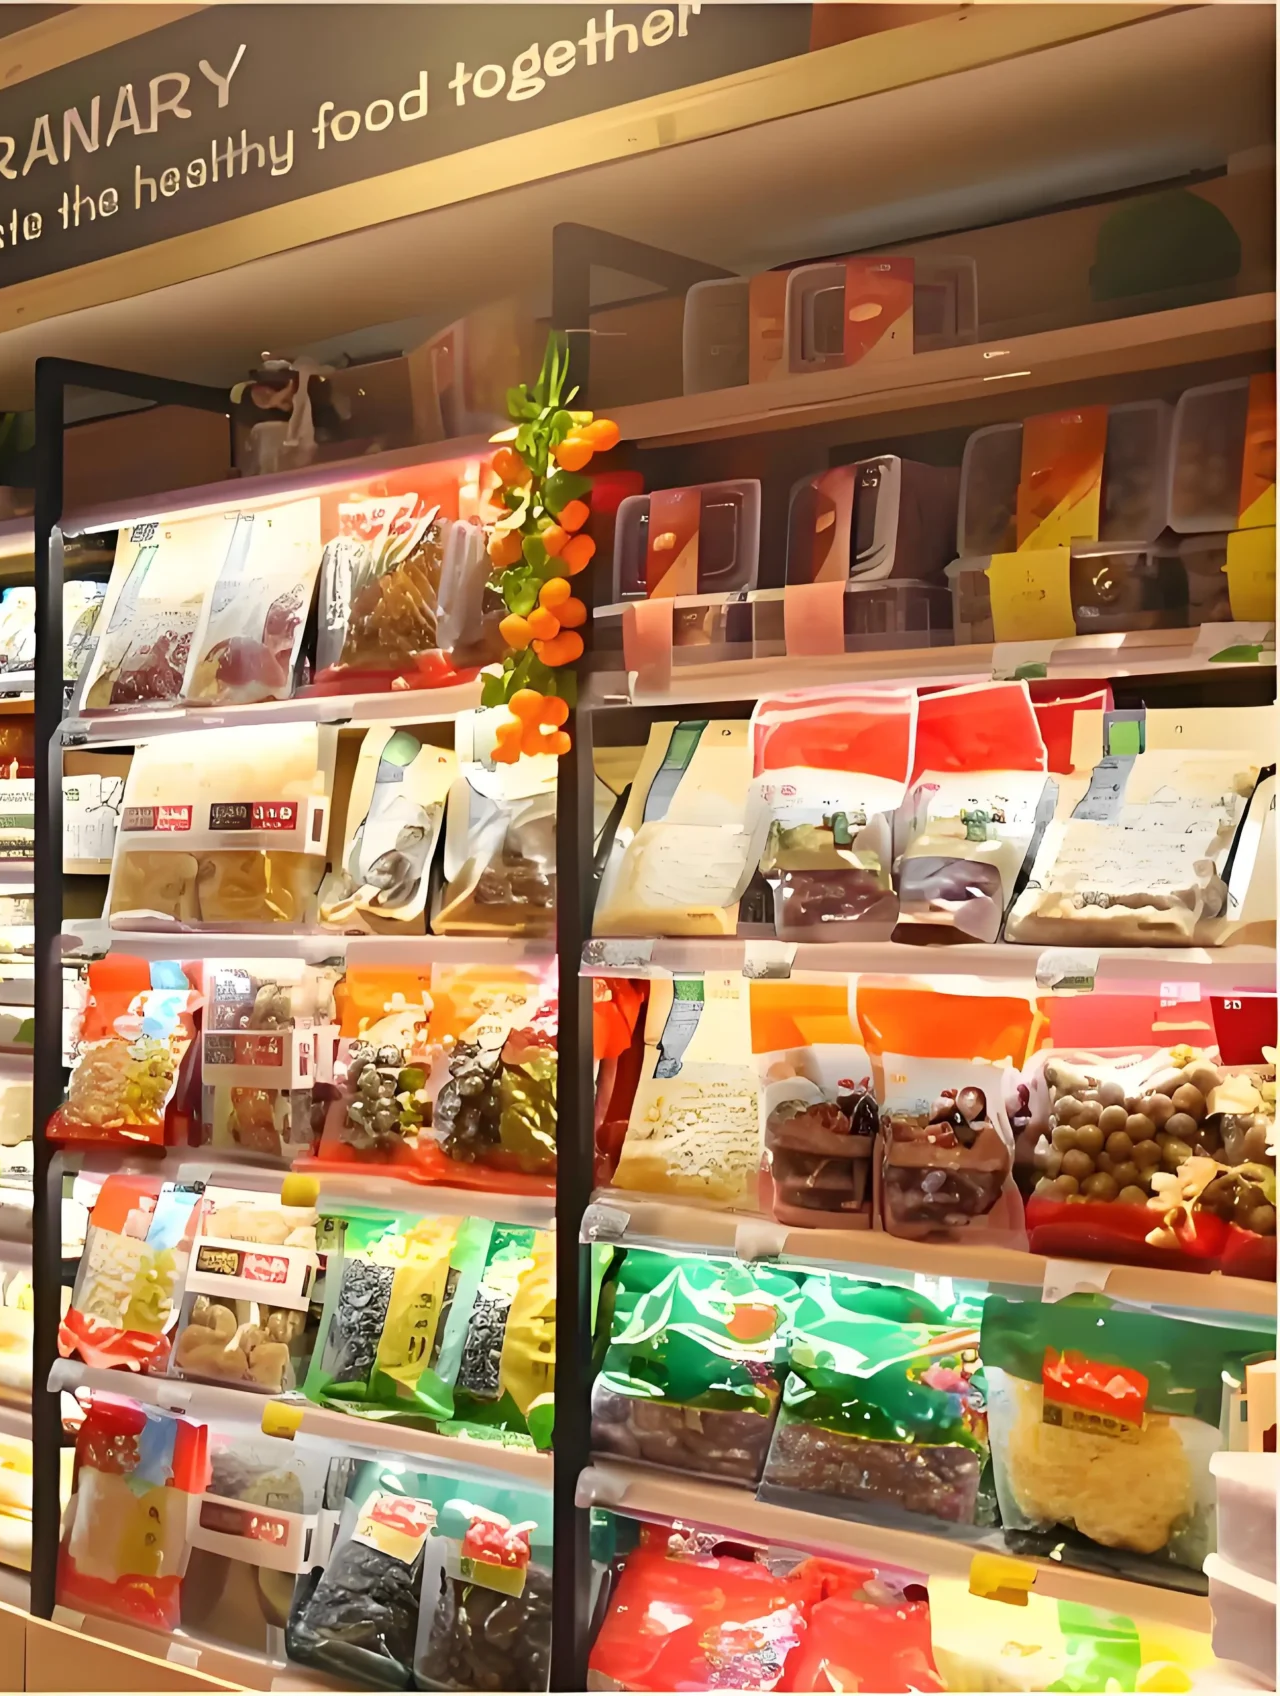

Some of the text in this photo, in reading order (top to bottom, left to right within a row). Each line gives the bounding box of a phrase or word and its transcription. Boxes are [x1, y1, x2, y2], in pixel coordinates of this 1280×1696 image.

[58, 184, 119, 230] the
[135, 129, 294, 210] healthy
[312, 70, 428, 149] food
[448, 4, 702, 107] together
